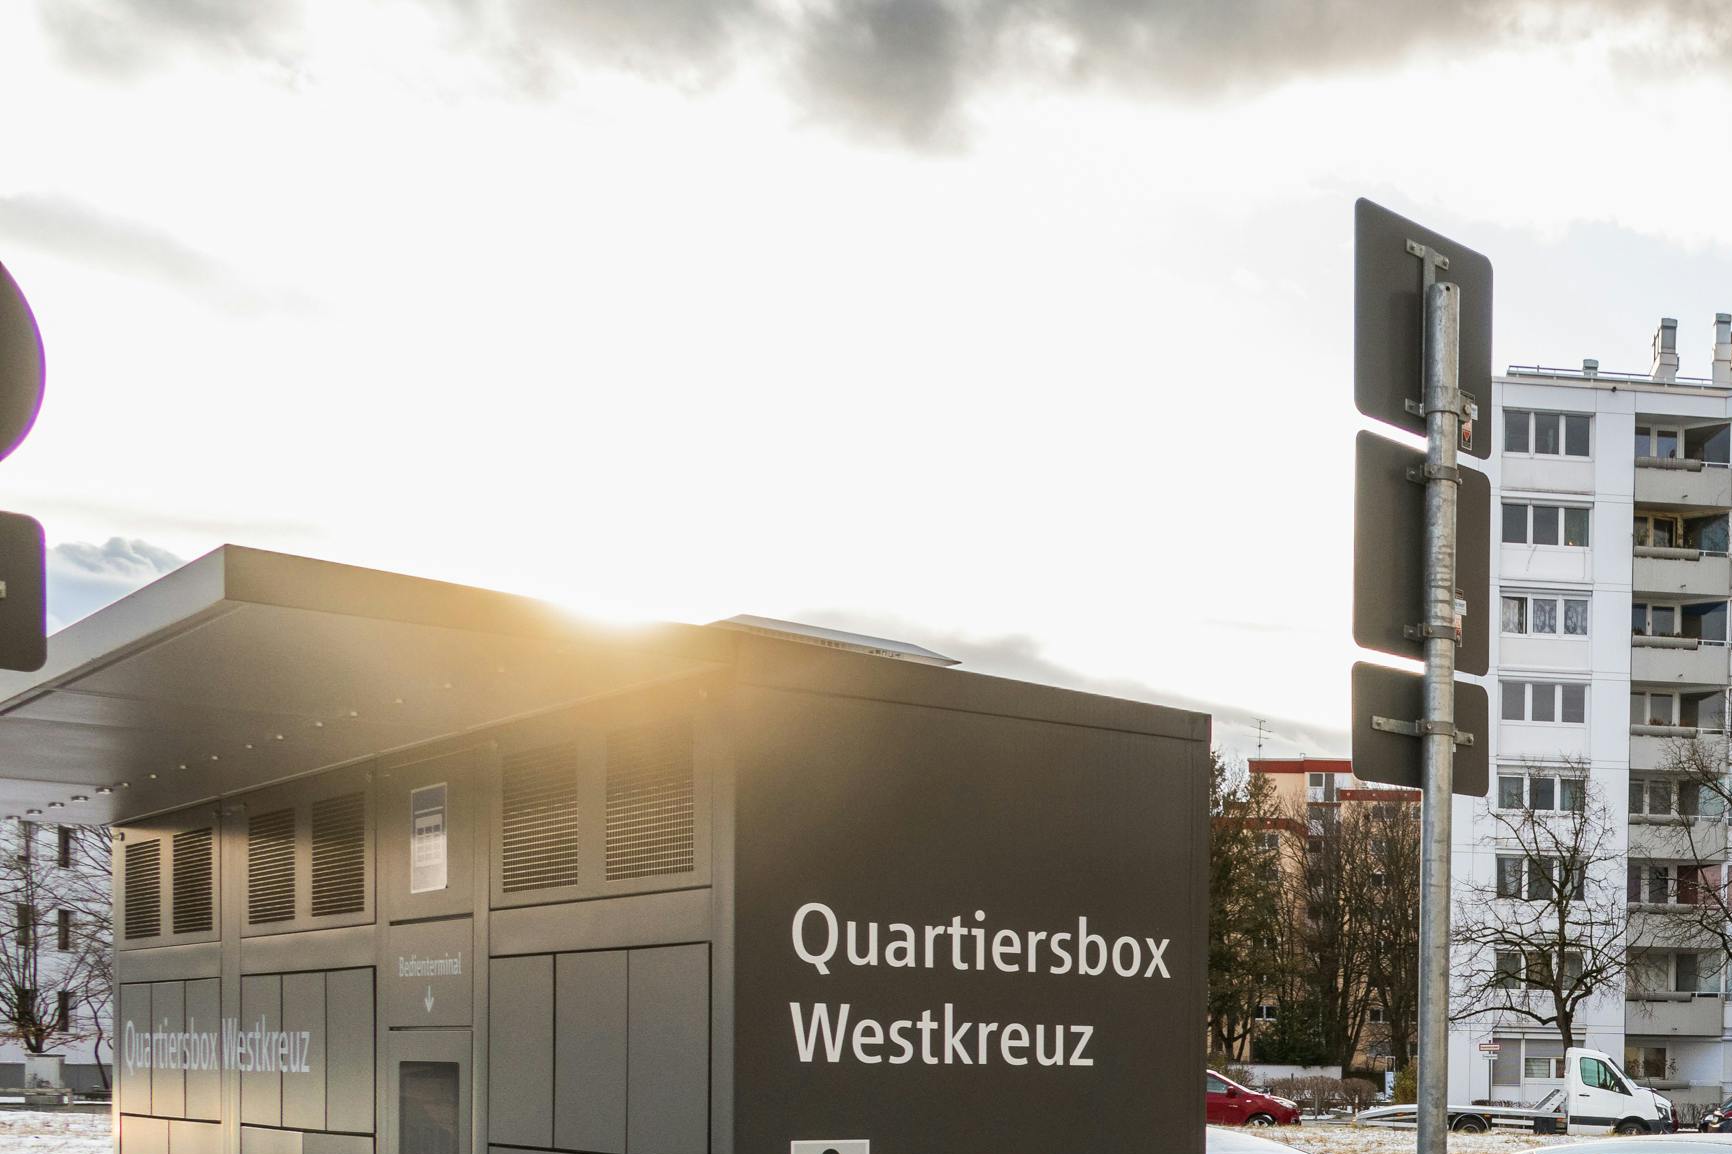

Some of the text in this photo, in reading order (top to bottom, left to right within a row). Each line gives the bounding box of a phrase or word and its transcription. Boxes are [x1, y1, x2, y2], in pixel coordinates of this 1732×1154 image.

[399, 952, 461, 977] Bedienterminal
[792, 903, 1171, 978] Quartiersbox
[125, 1014, 310, 1076] Quartiersbox Westkreuz
[789, 1002, 1093, 1066] Westkreuz
